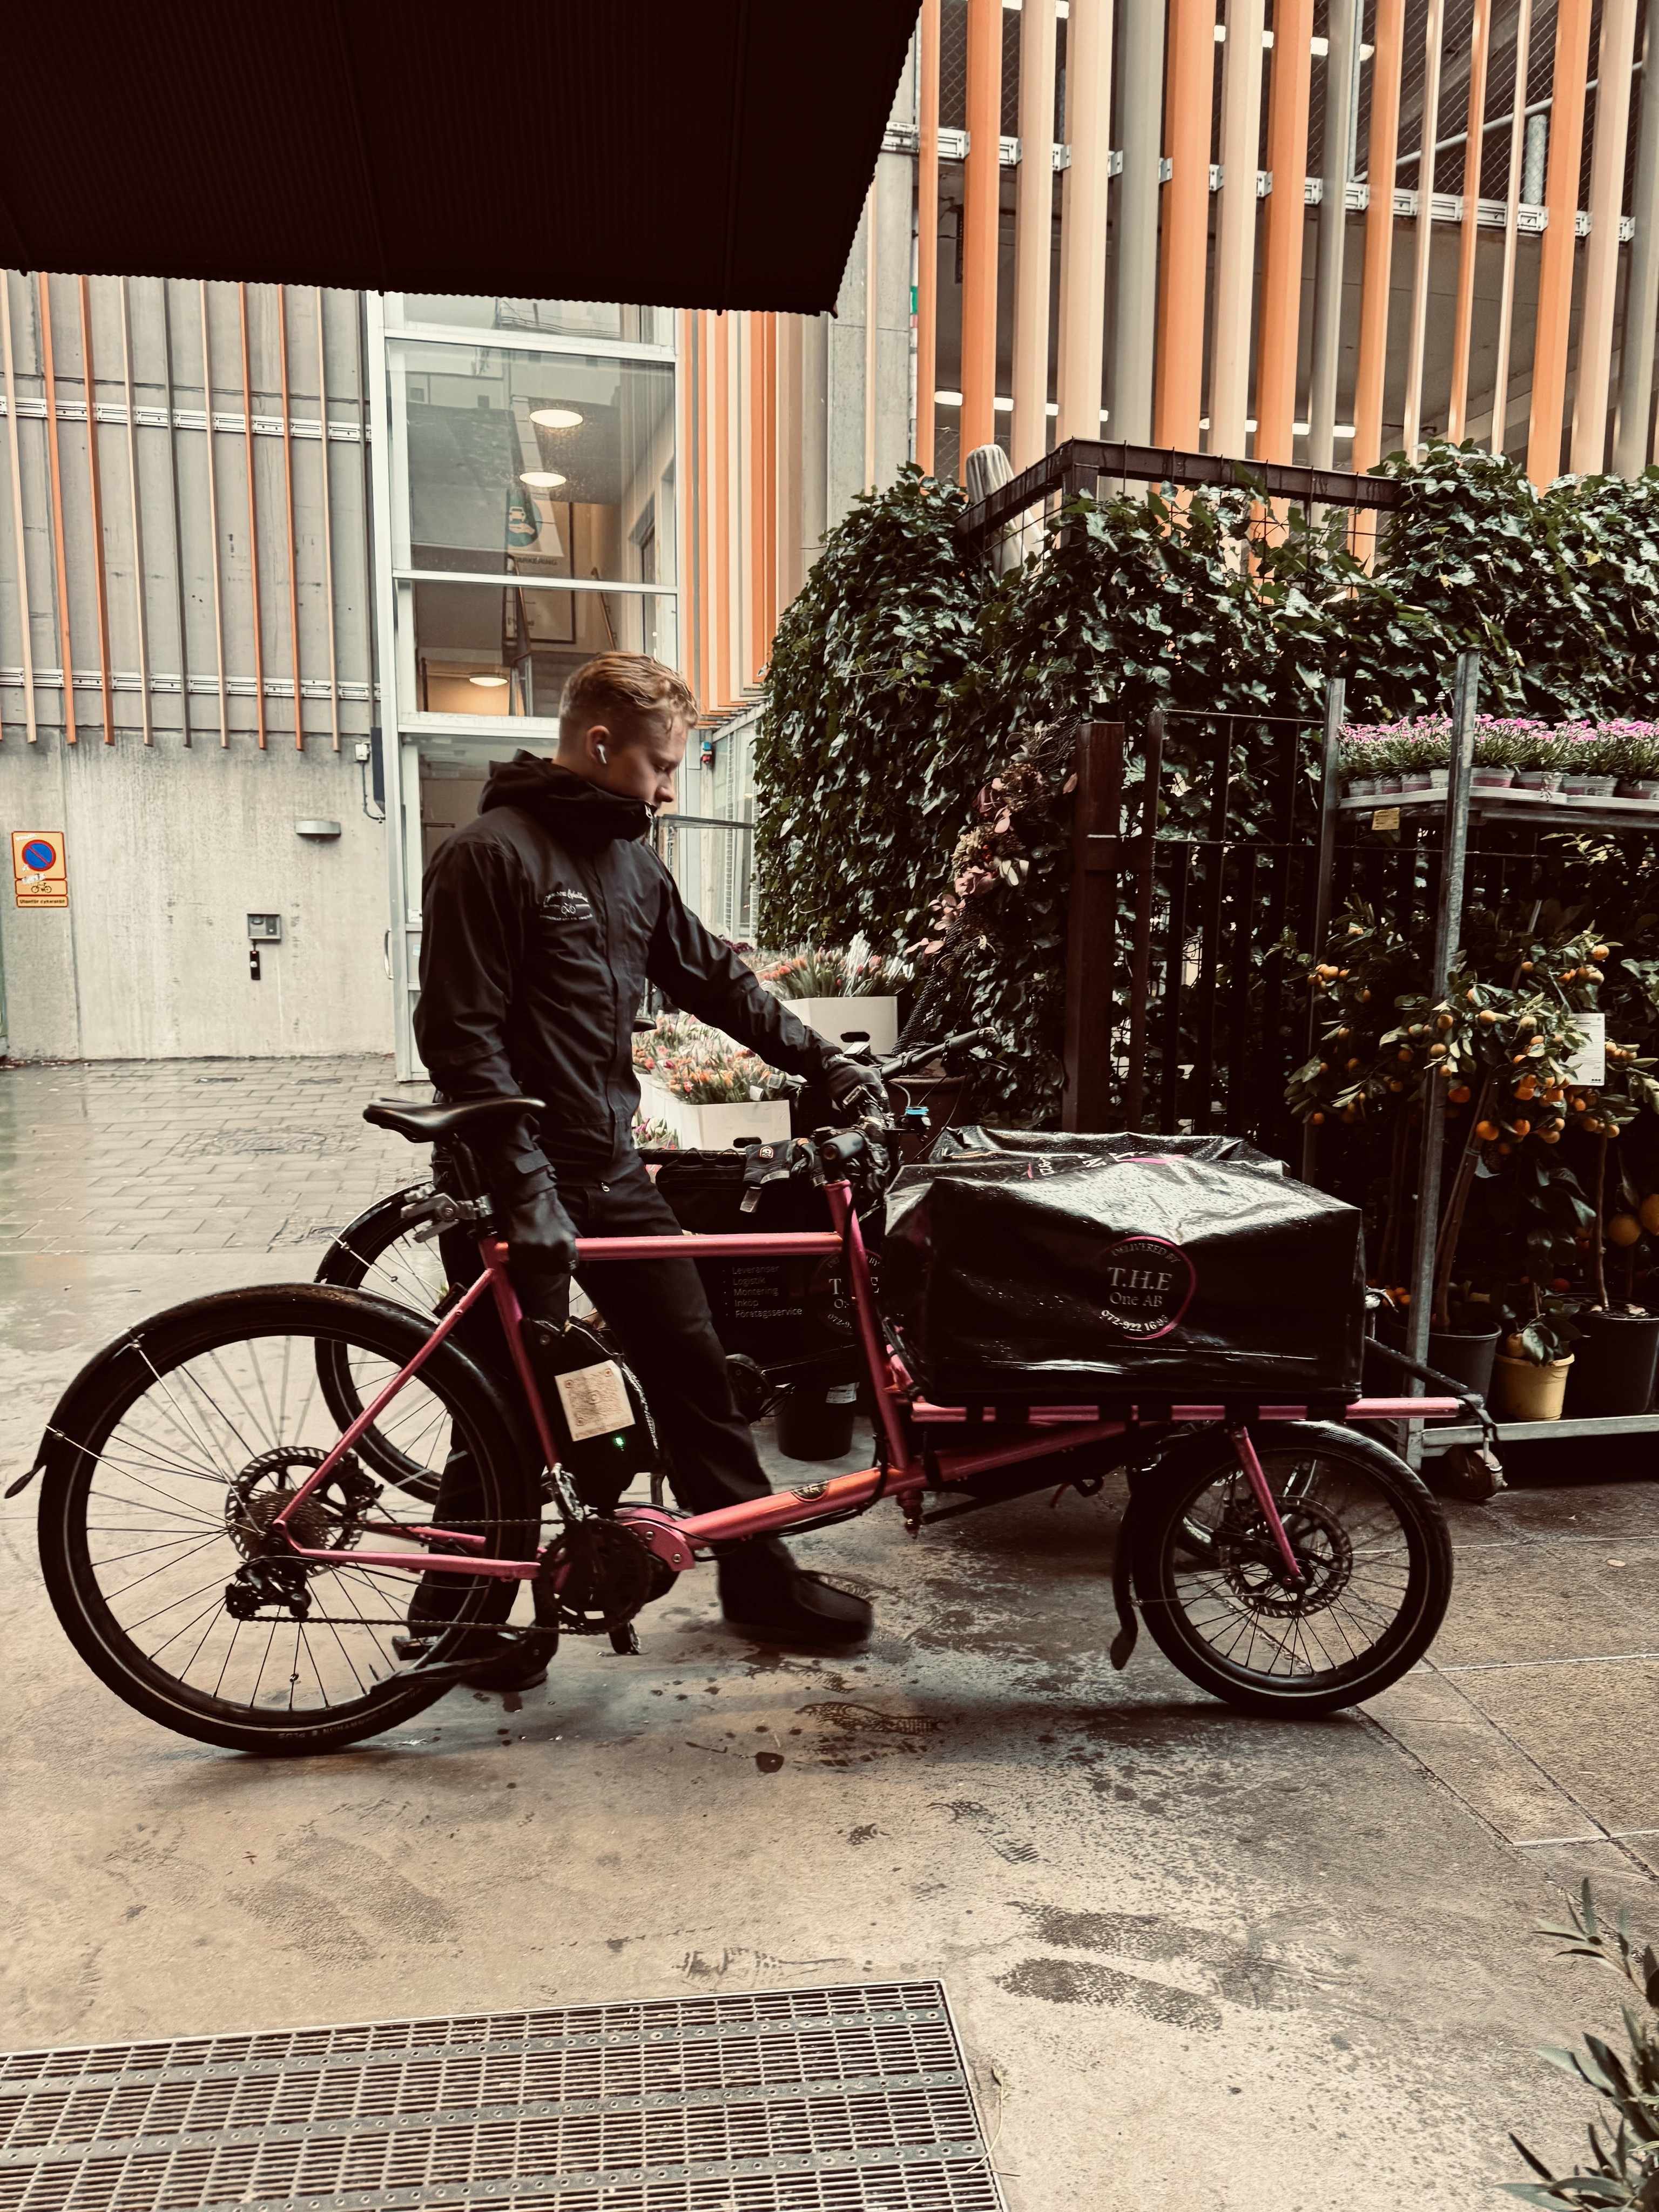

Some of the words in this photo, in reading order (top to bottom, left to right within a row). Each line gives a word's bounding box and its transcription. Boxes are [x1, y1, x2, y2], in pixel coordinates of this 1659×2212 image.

[517, 557, 557, 565] ARKERING
[1110, 1243, 1168, 1256] DELIVERED
[1165, 1252, 1181, 1263] BY
[732, 1265, 780, 1275] Leveranser
[732, 1276, 766, 1286] Logistik
[1107, 1266, 1173, 1291] T.H.E
[733, 1287, 779, 1297] Montering
[734, 1298, 759, 1308] Inköp
[1109, 1292, 1140, 1305] One
[1142, 1295, 1163, 1307] AB
[735, 1307, 803, 1319] Företagsservice
